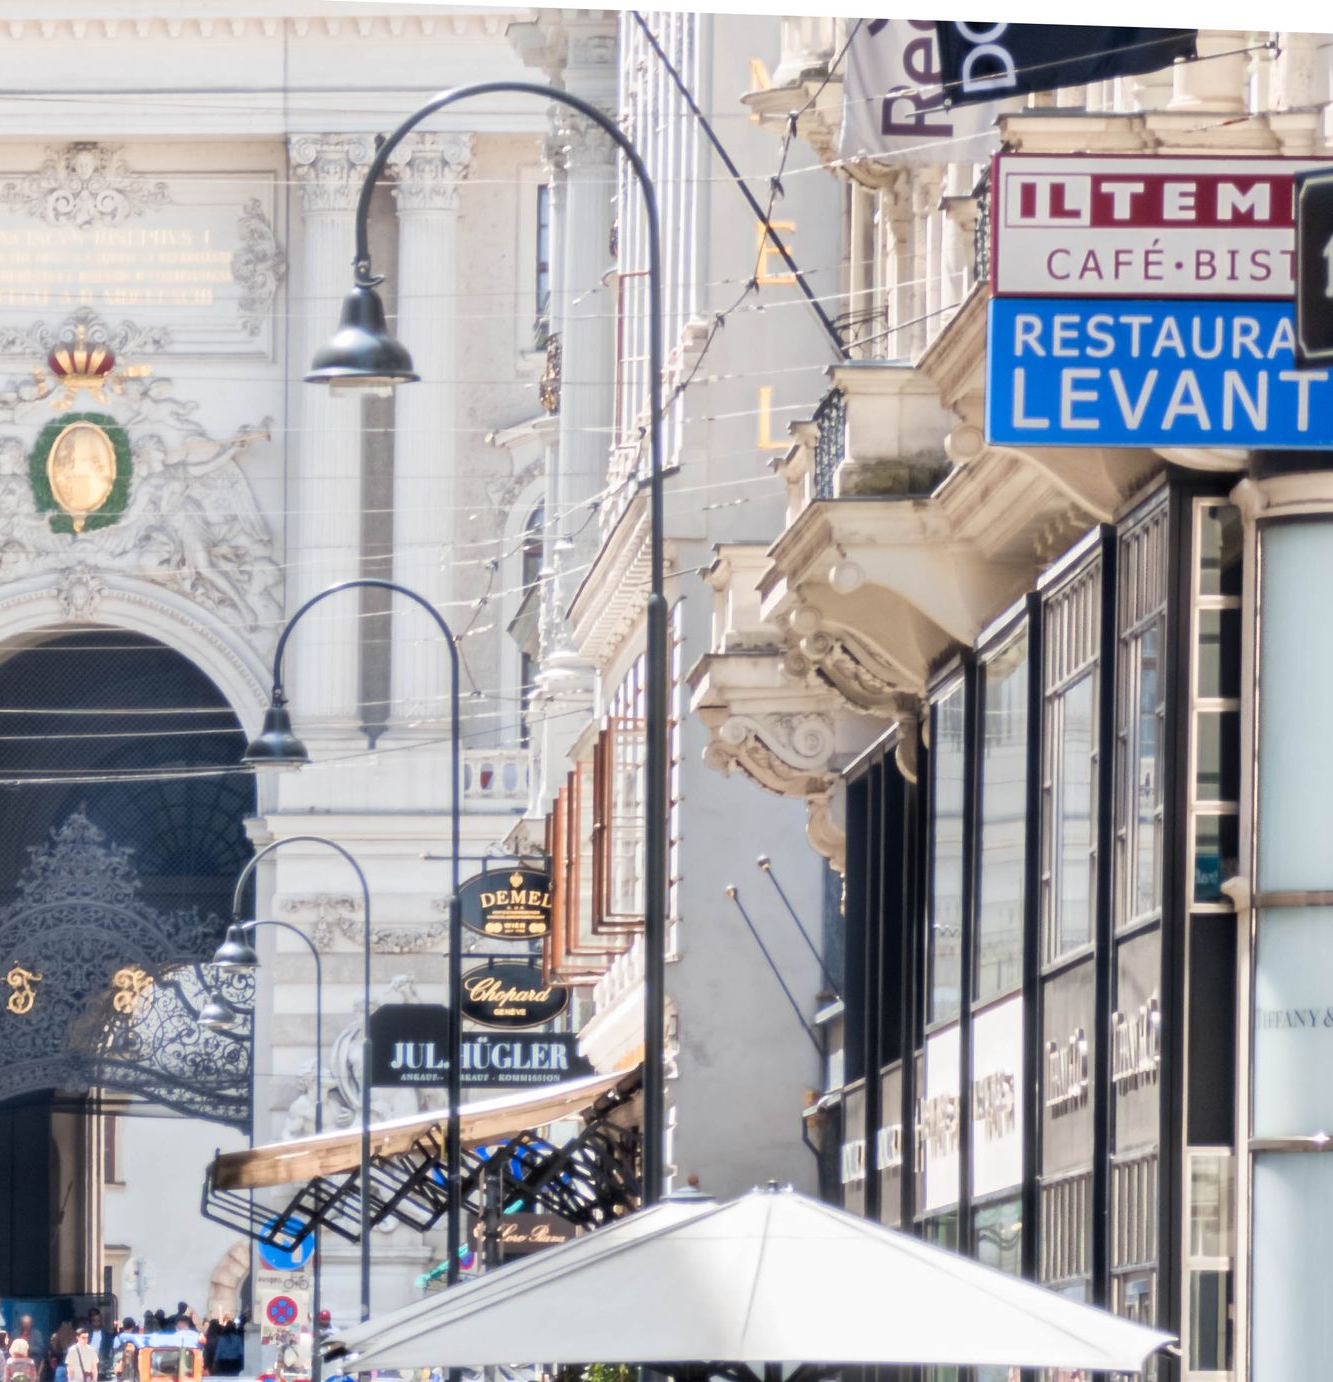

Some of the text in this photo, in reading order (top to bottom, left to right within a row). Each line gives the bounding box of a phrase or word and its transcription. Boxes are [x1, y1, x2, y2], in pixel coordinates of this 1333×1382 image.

[882, 20, 953, 137] Re
[1100, 182, 1295, 221] TEM
[1012, 367, 1330, 433] LEVANT
[479, 889, 552, 909] DEMEL
[464, 976, 552, 1008] Chopard
[390, 1042, 450, 1070] JUL.
